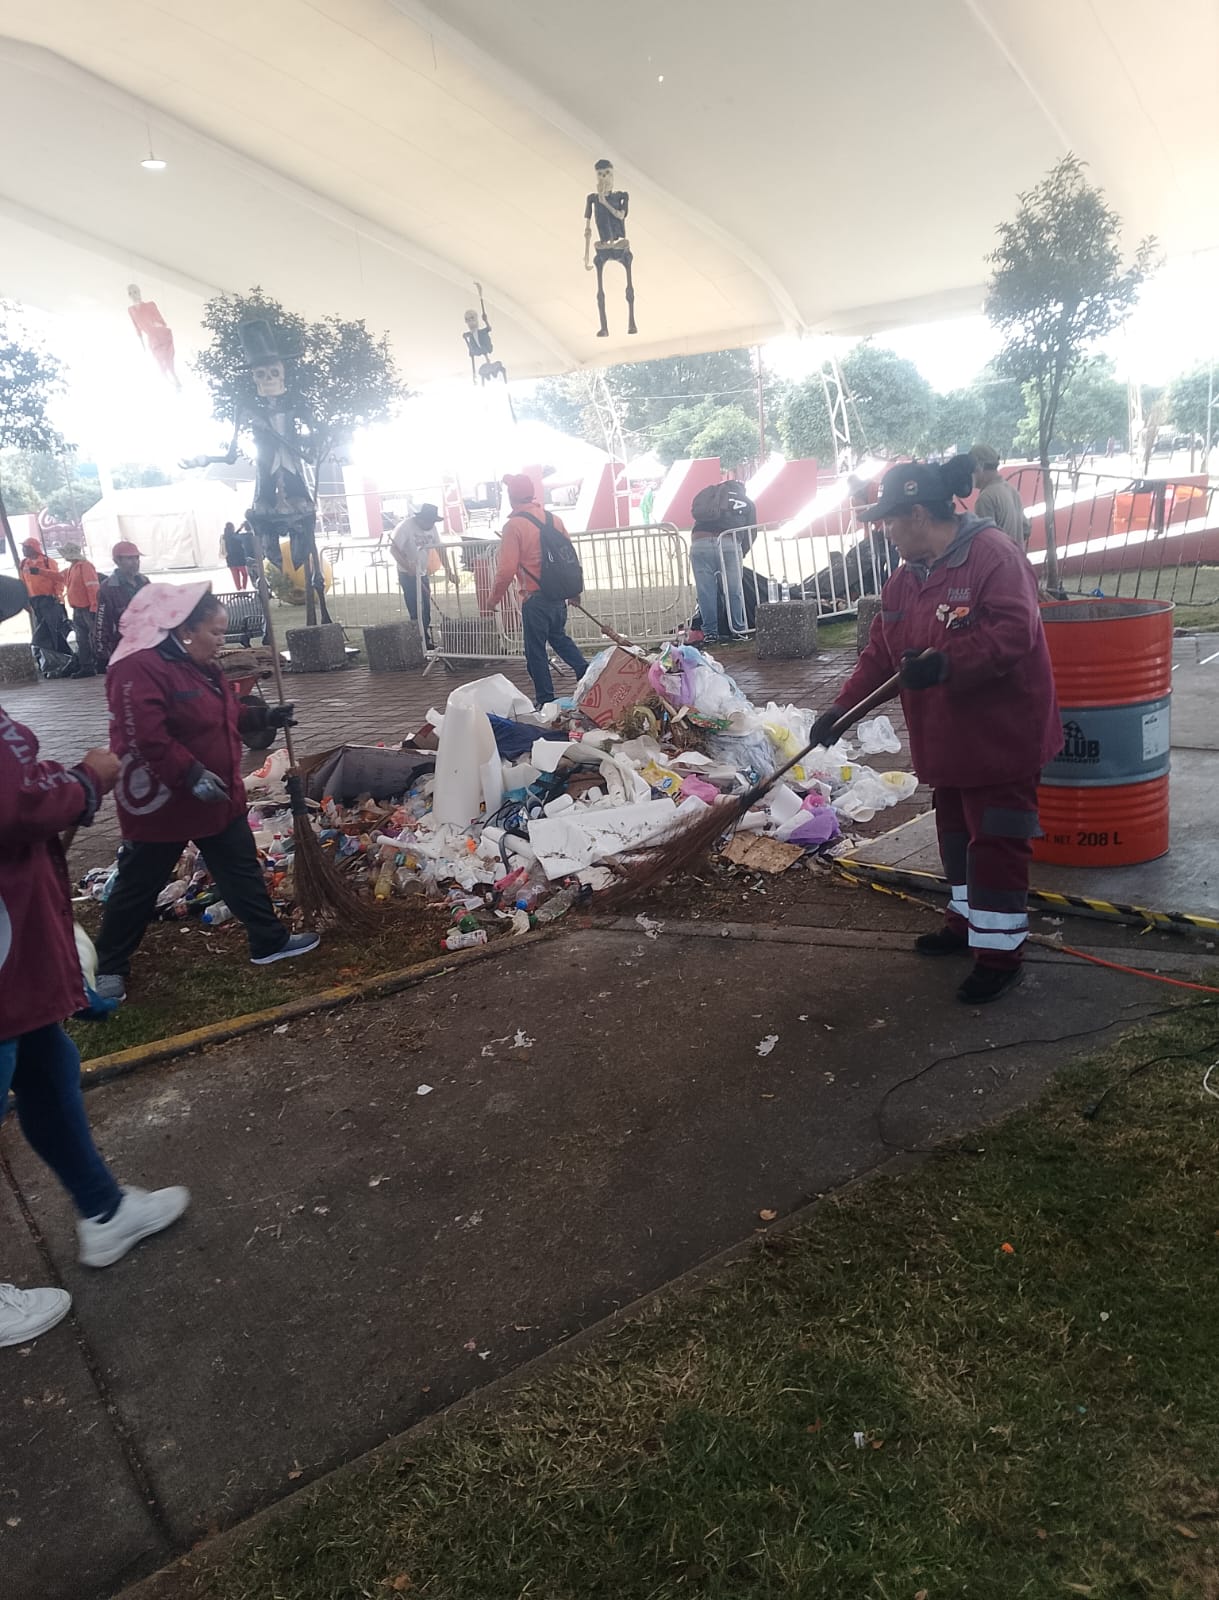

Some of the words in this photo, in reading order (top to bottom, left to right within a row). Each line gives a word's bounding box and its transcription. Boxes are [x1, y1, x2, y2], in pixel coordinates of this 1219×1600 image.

[97, 603, 105, 629] CAPITAL
[122, 681, 136, 736] CAPITAL
[1058, 740, 1100, 757] LUB
[1077, 832, 1108, 846] 208
[1113, 832, 1123, 845] L
